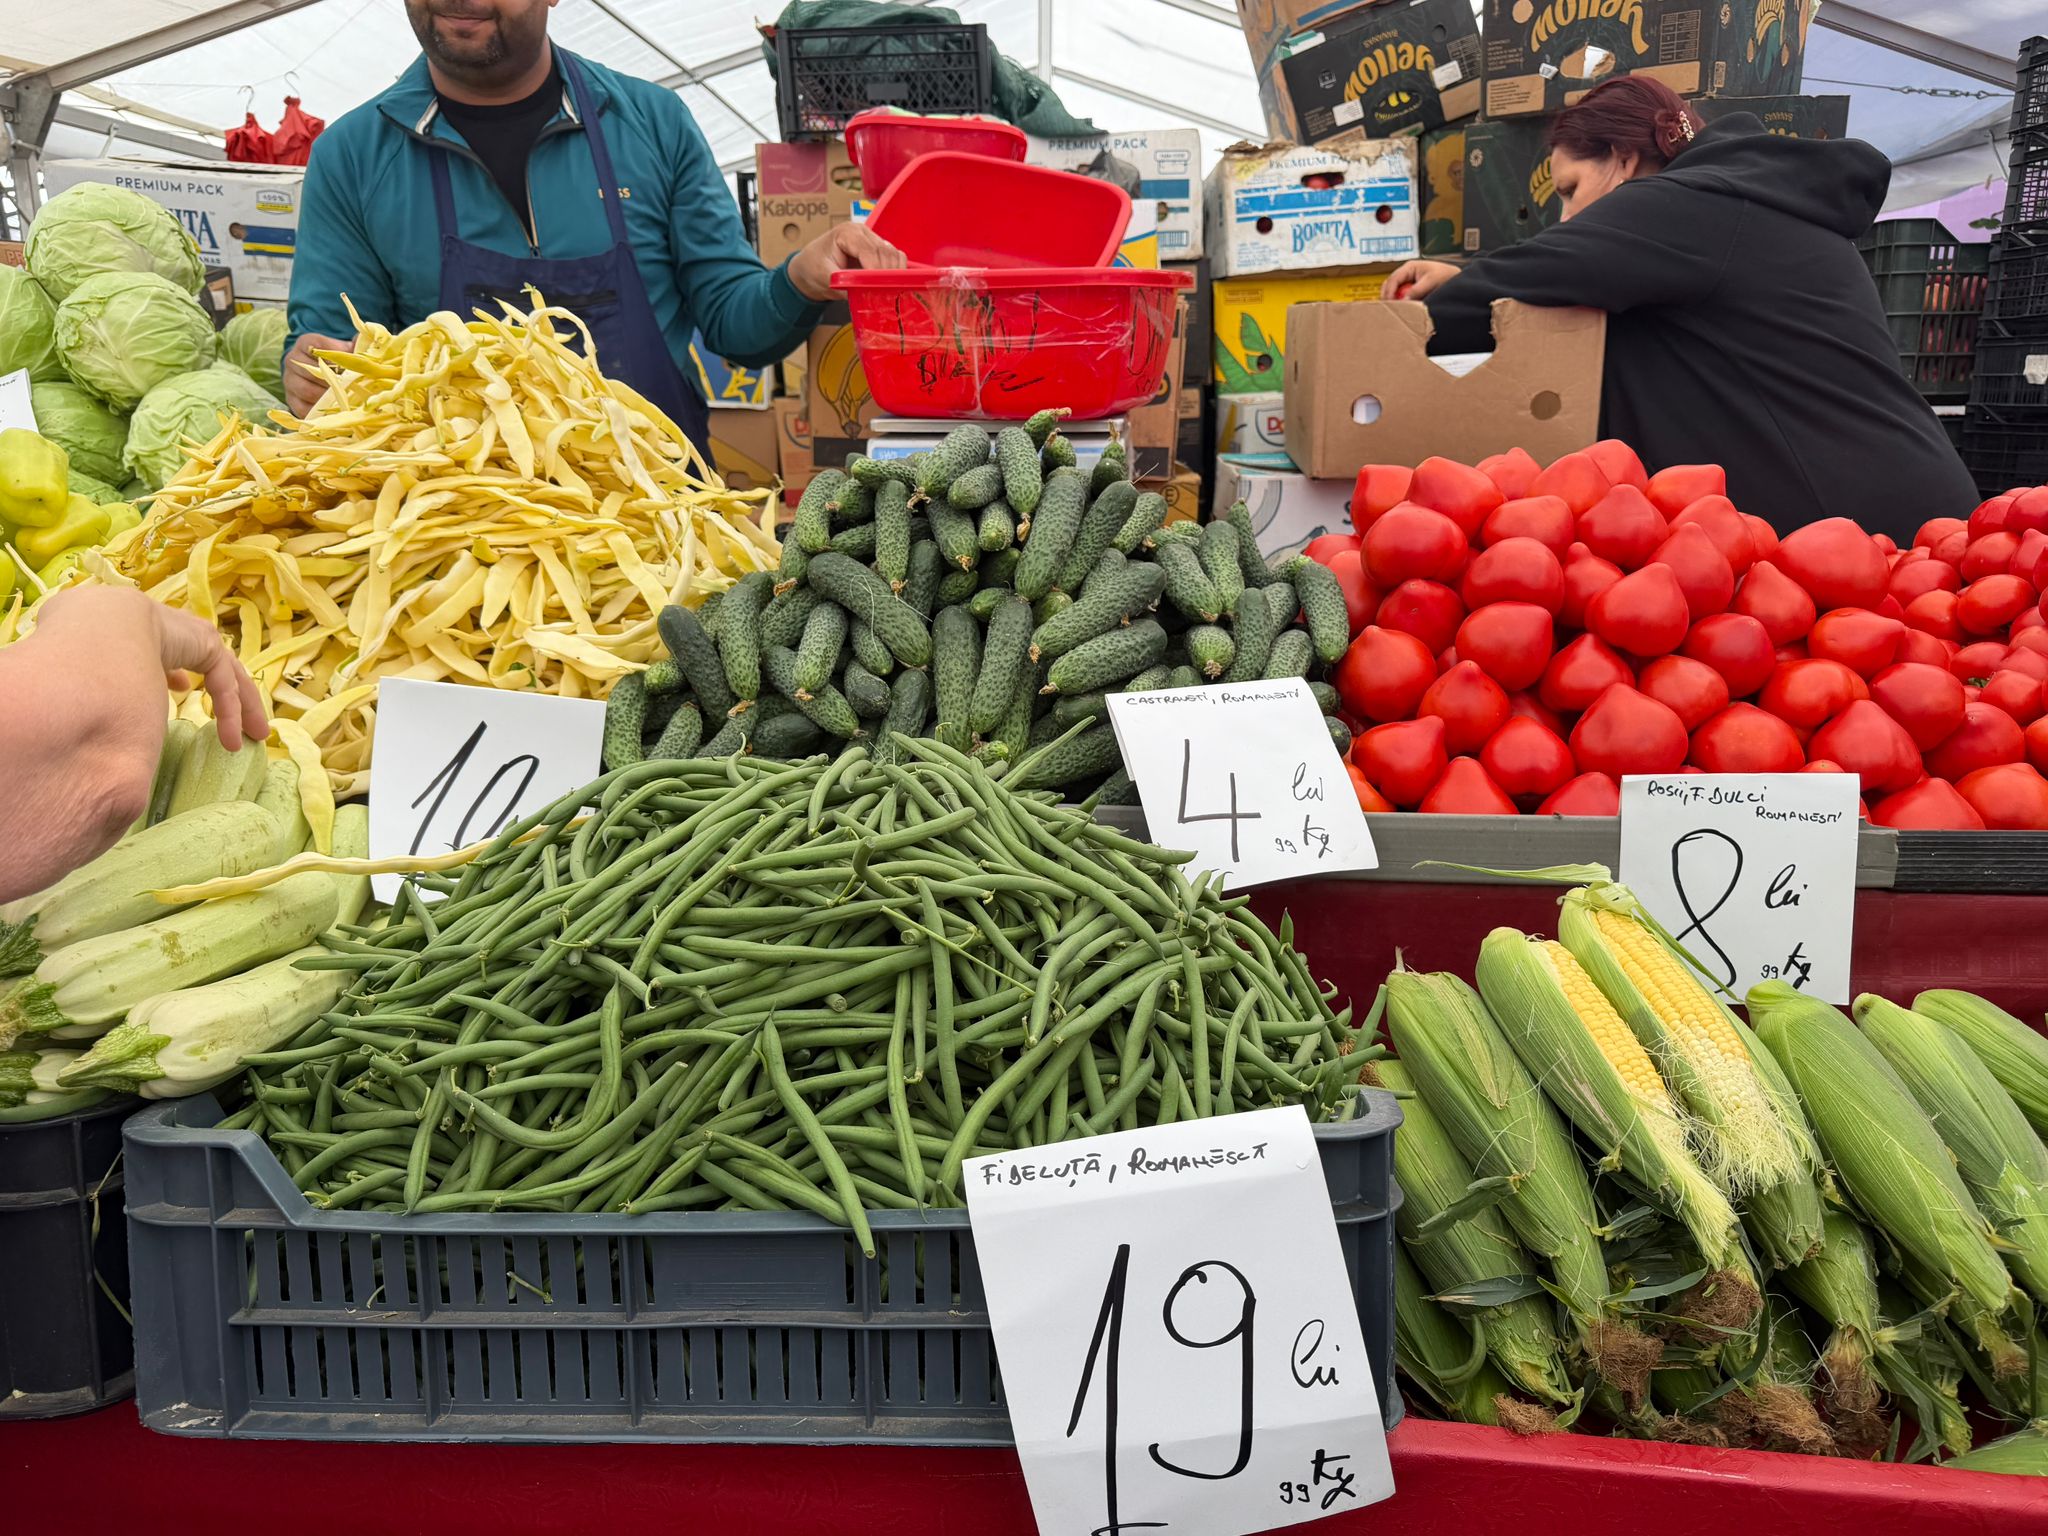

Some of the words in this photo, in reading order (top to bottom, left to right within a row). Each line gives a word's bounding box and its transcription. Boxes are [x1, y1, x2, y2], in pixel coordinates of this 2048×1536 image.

[1344, 42, 1444, 103] yellow
[1114, 138, 1148, 149] PACK
[115, 176, 182, 193] PREMIUM
[187, 182, 224, 196] PACK
[762, 200, 829, 222] Katope
[1292, 219, 1356, 254] BONITA
[1178, 738, 1262, 862] 4
[1671, 828, 1744, 993] 8
[1066, 1243, 1257, 1536] 19
